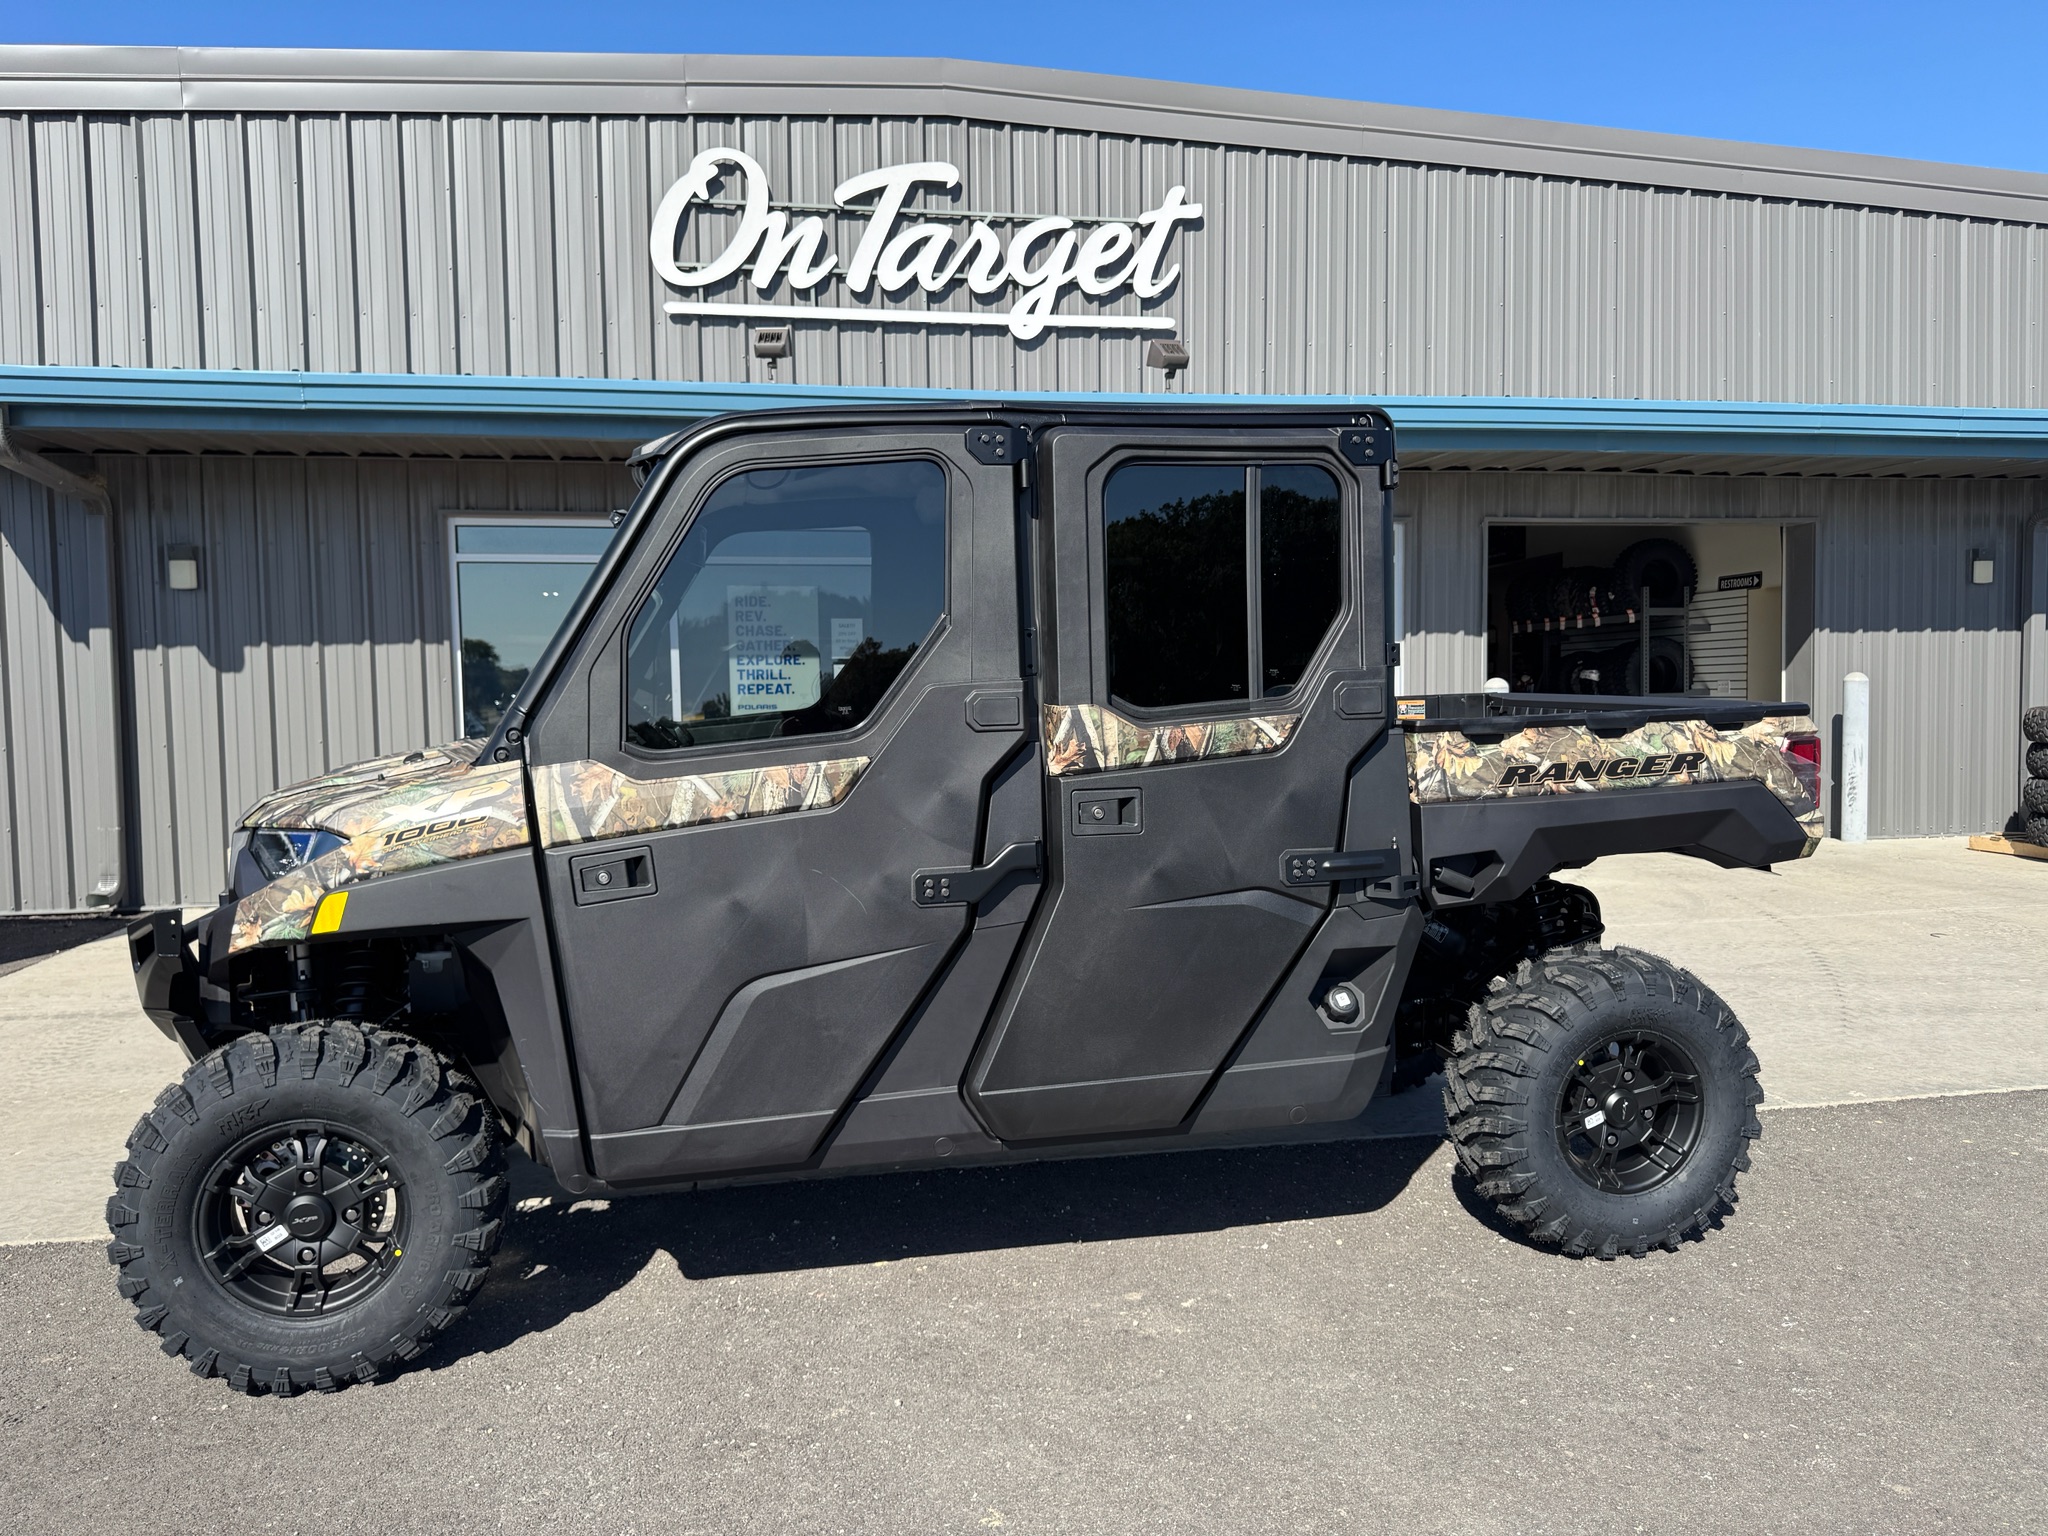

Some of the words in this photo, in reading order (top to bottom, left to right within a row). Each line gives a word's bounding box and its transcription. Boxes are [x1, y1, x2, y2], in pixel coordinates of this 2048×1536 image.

[650, 147, 838, 289] On
[834, 161, 1203, 340] Target
[1720, 576, 1753, 589] RESTROOMS
[735, 595, 771, 608] RIDE.
[735, 610, 766, 622] REV.
[736, 625, 787, 637] CHASE.
[736, 640, 796, 651] GATHER.
[736, 655, 805, 666] EXPLORE.
[737, 669, 791, 680] THRILL.
[737, 683, 795, 695] REPEAT.
[1499, 752, 1706, 787] RANGER
[361, 780, 512, 834] XP
[383, 815, 488, 847] 1000
[292, 1215, 318, 1225] XP
